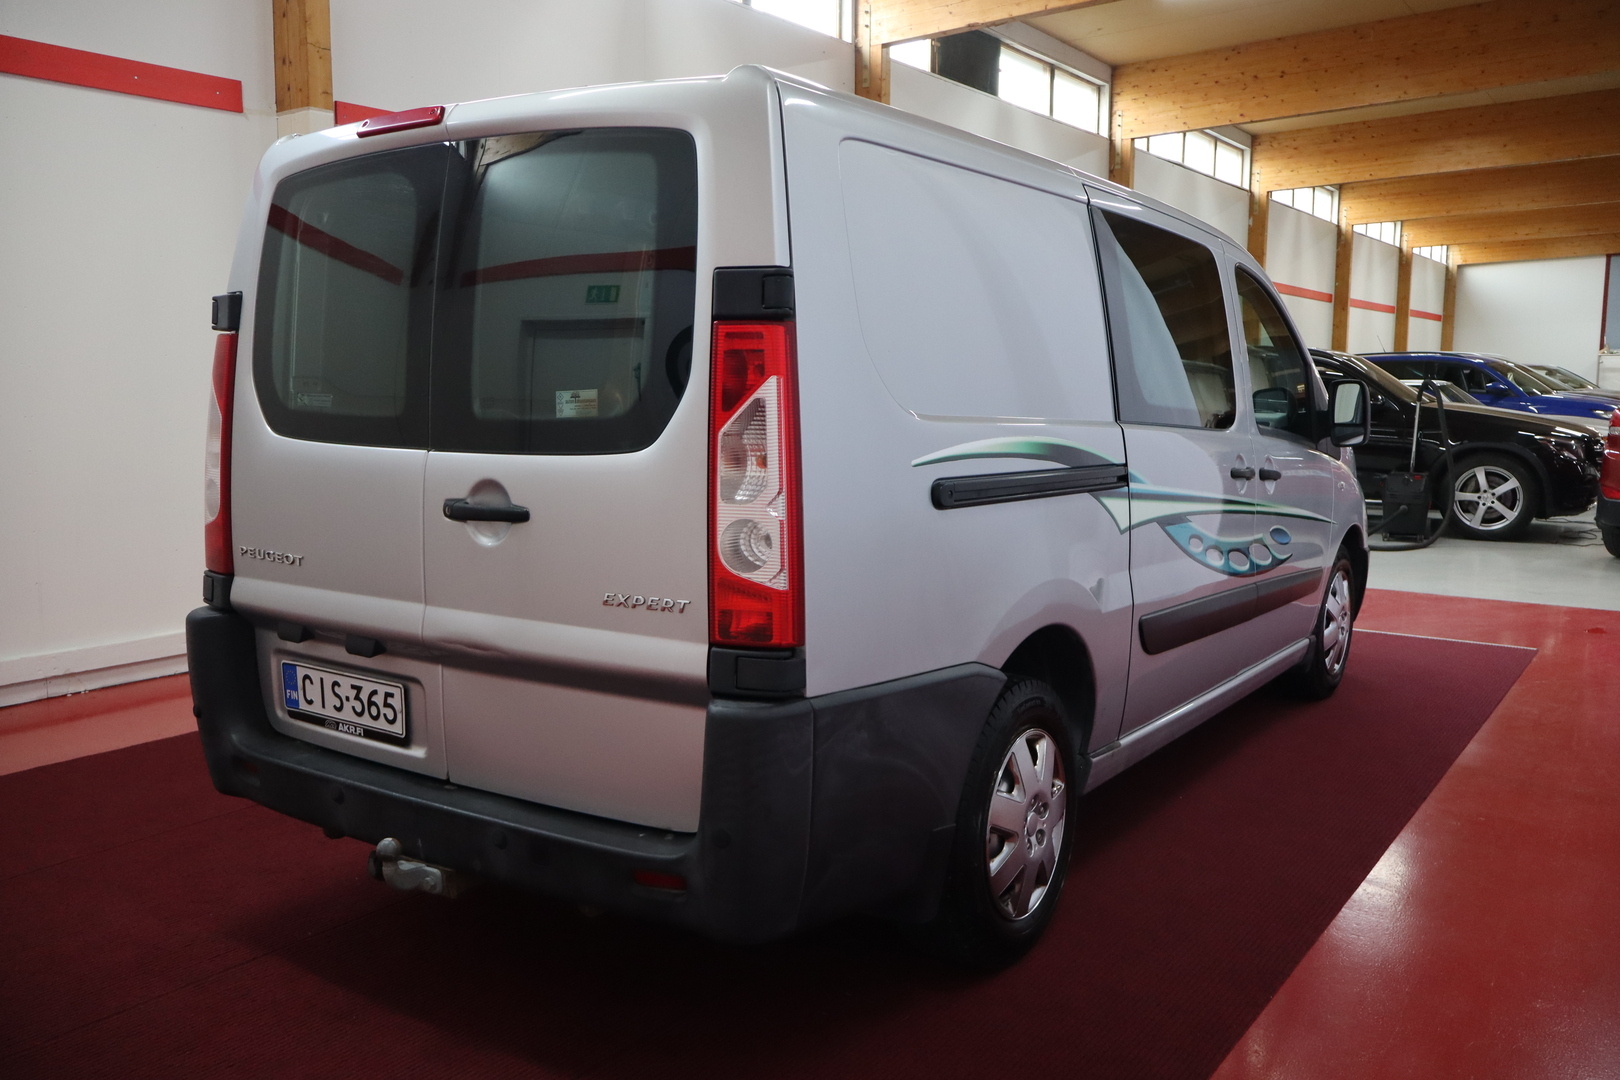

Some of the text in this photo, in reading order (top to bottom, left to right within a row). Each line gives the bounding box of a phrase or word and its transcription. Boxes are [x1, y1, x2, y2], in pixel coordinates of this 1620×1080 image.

[239, 545, 304, 567] PEUGEOT
[602, 592, 691, 614] EXPERT
[286, 689, 299, 701] FIN
[301, 673, 398, 725] CIS-365
[338, 722, 364, 737] AKR.FI
